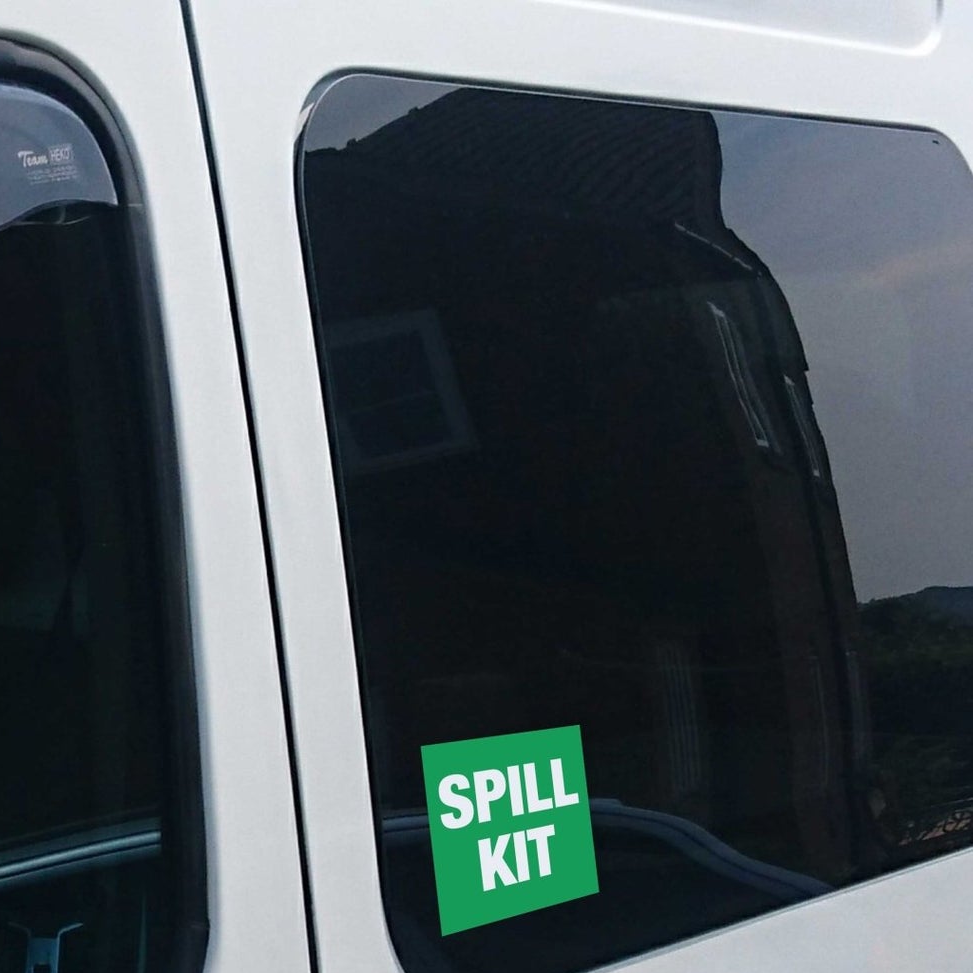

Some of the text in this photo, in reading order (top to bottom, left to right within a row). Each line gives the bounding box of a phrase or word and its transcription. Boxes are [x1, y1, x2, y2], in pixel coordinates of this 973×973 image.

[17, 150, 48, 168] Team
[438, 758, 579, 829] SPILL
[477, 824, 555, 892] KIT
